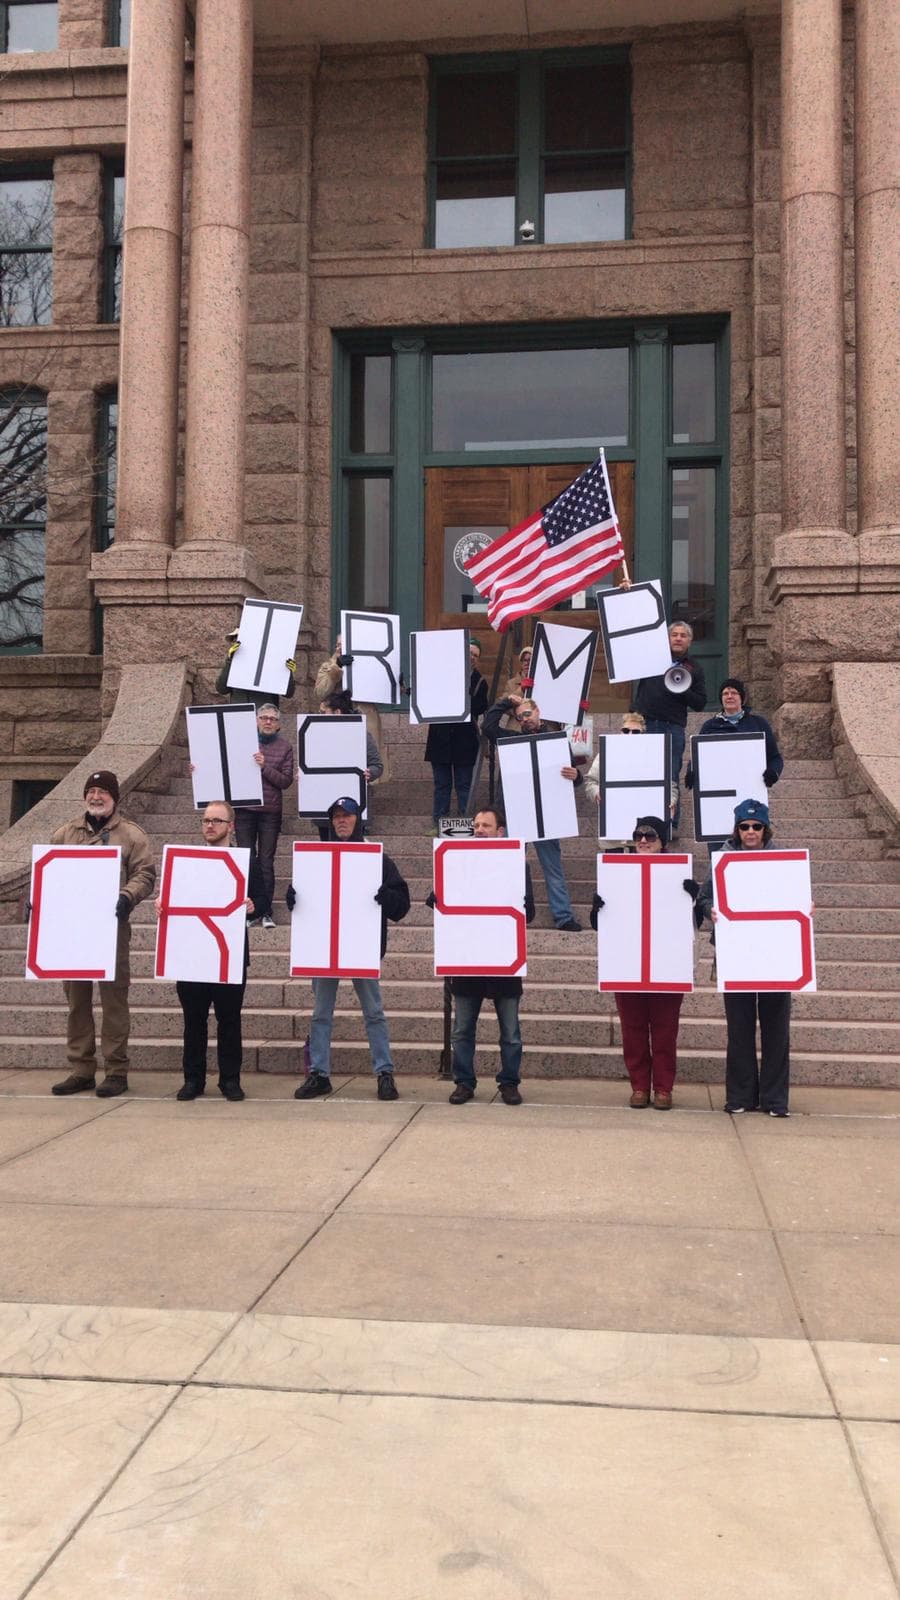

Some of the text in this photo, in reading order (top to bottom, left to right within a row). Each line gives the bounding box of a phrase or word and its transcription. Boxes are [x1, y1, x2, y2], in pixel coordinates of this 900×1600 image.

[245, 582, 666, 726] TRUMP
[189, 704, 766, 842] IS THE
[441, 819, 475, 828] ENTRANC
[28, 840, 812, 992] CRISIS
